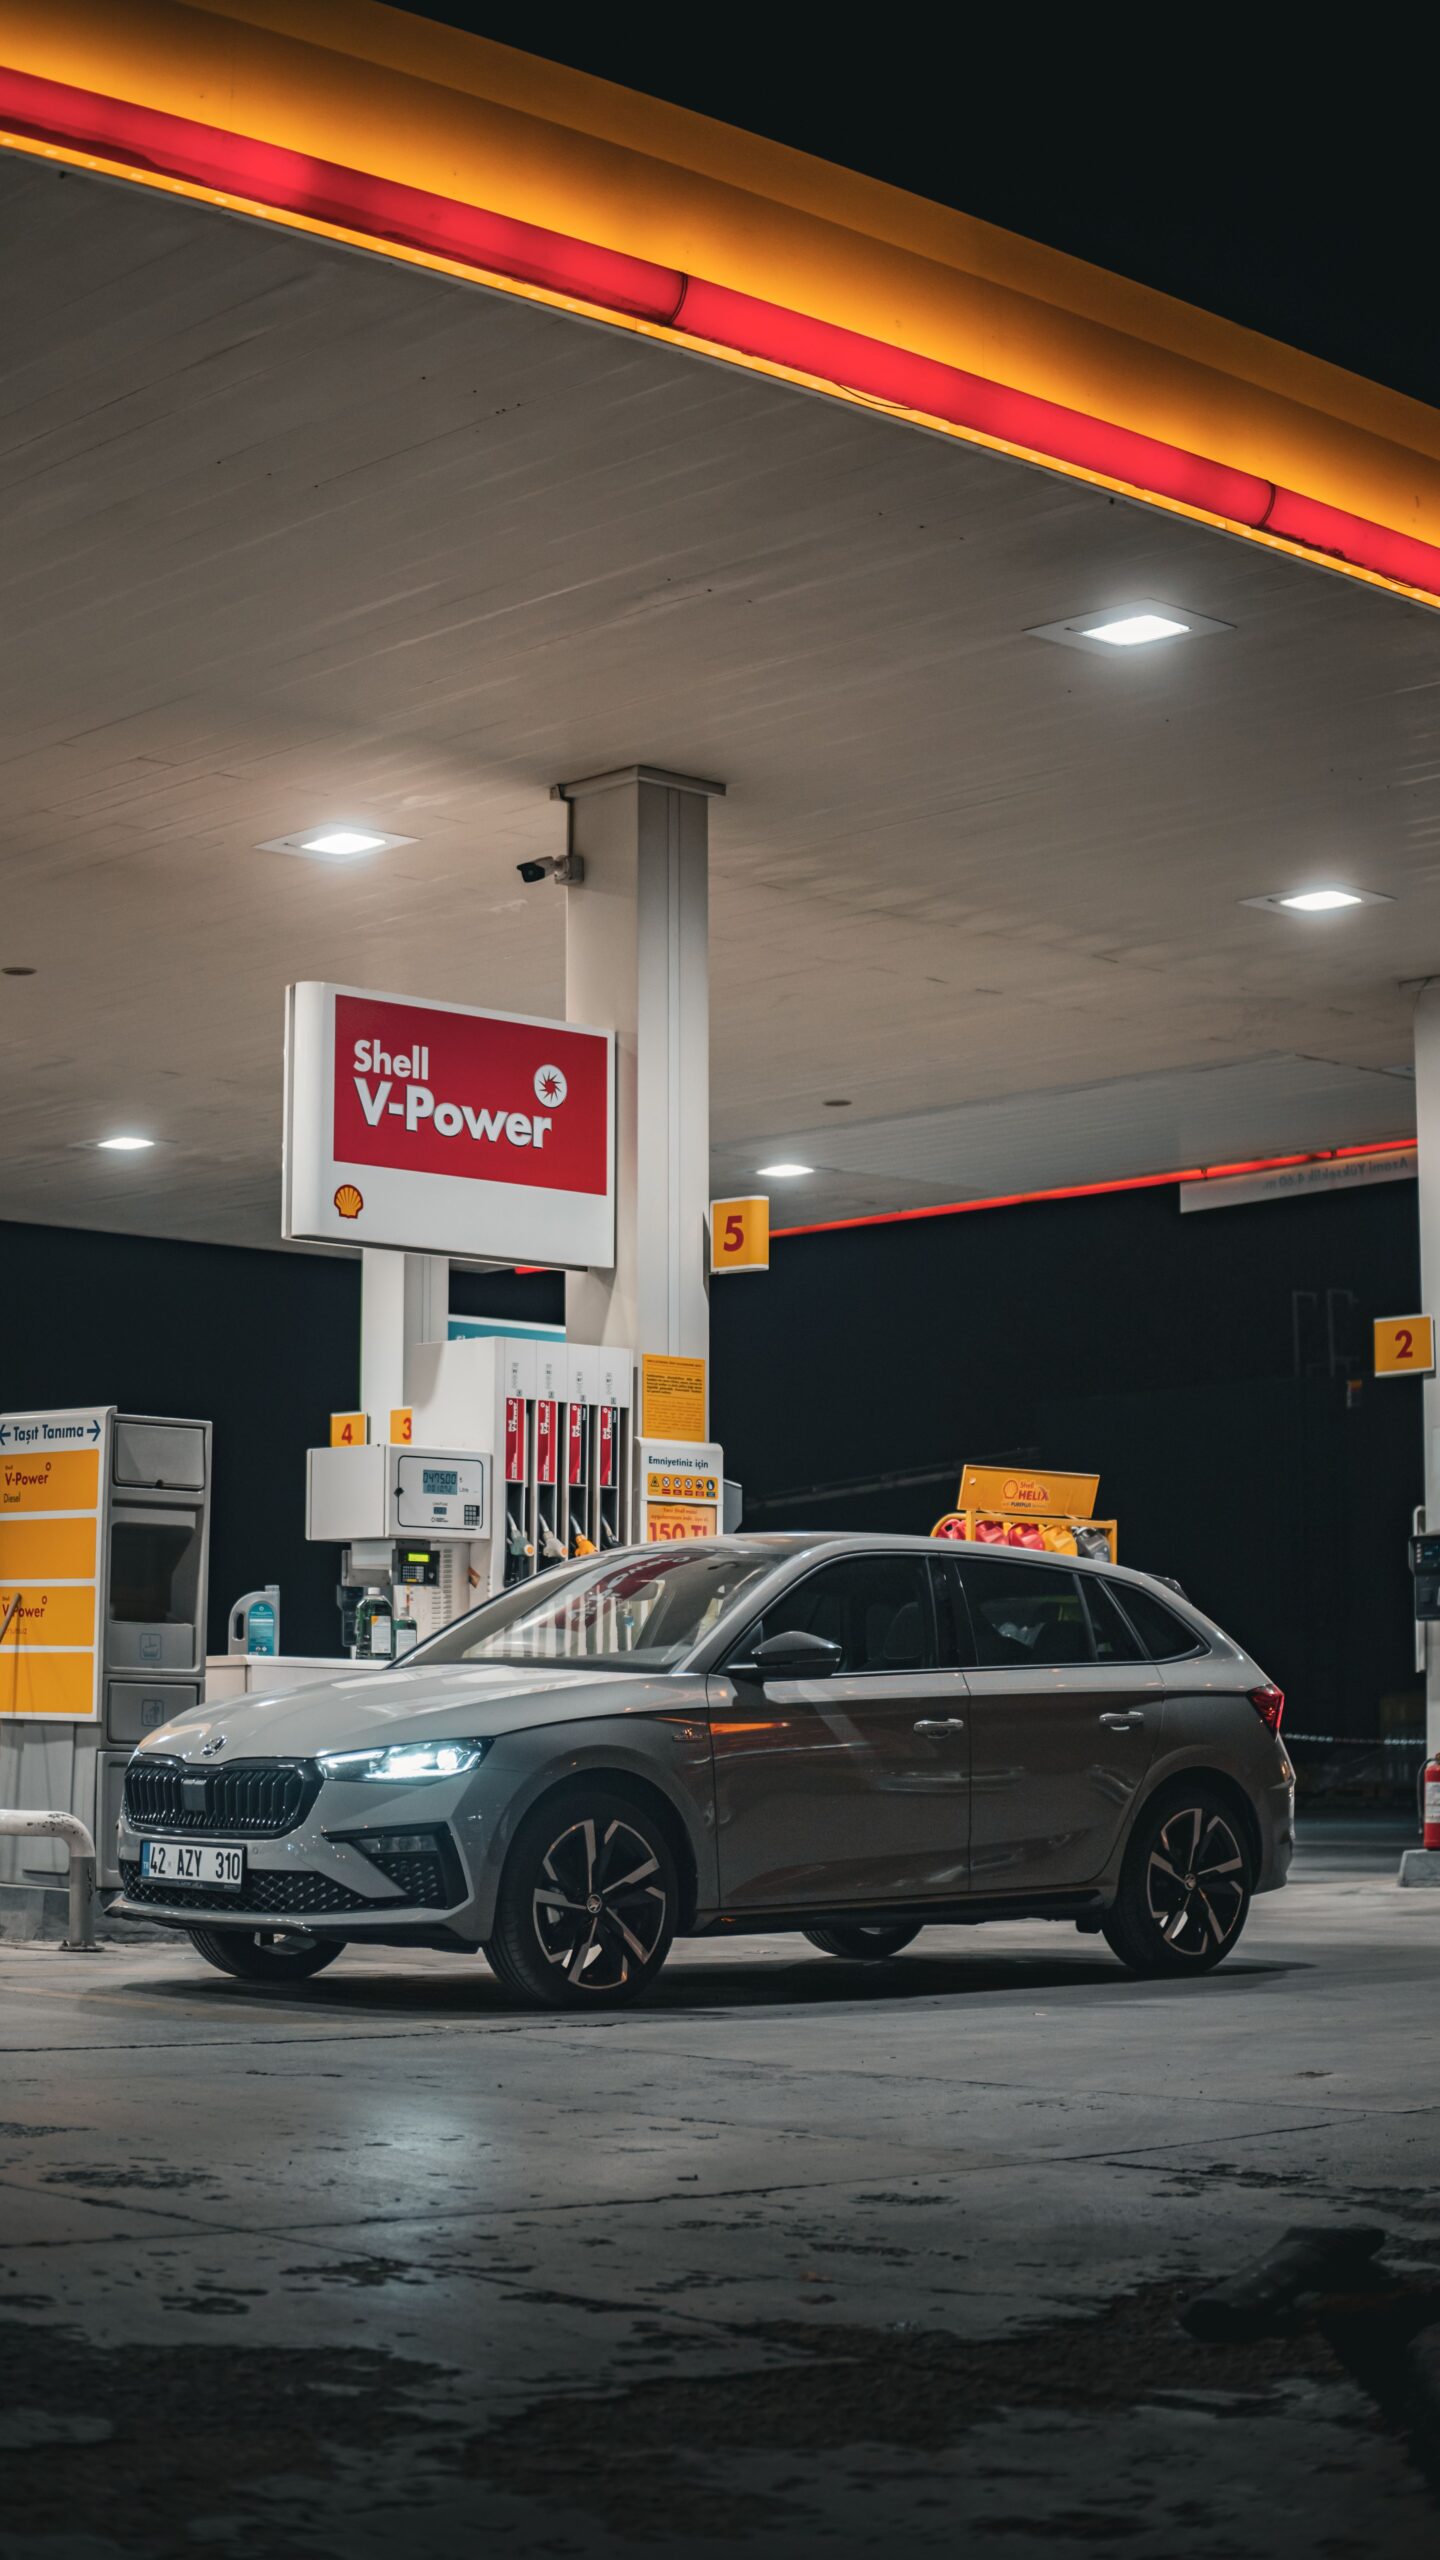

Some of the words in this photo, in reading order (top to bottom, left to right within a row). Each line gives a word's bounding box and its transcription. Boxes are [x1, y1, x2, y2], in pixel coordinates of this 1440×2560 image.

[353, 1039, 429, 1081] Shell
[353, 1076, 553, 1149] V-Power
[723, 1215, 744, 1252] 5
[1395, 1329, 1413, 1359] 2
[13, 1426, 39, 1445] Taşıt
[42, 1424, 84, 1440] Tanıma
[341, 1423, 353, 1445] 4
[402, 1417, 412, 1441] 3
[648, 1455, 693, 1468] Emniyetiniz
[695, 1460, 709, 1470] için
[5, 1472, 49, 1487] V-Power
[3, 1491, 21, 1503] Diesel
[1018, 1486, 1050, 1501] HELIX
[649, 1522, 686, 1542] 150
[150, 1847, 166, 1875] 42
[177, 1848, 202, 1878] AZY
[215, 1851, 241, 1881] 310
